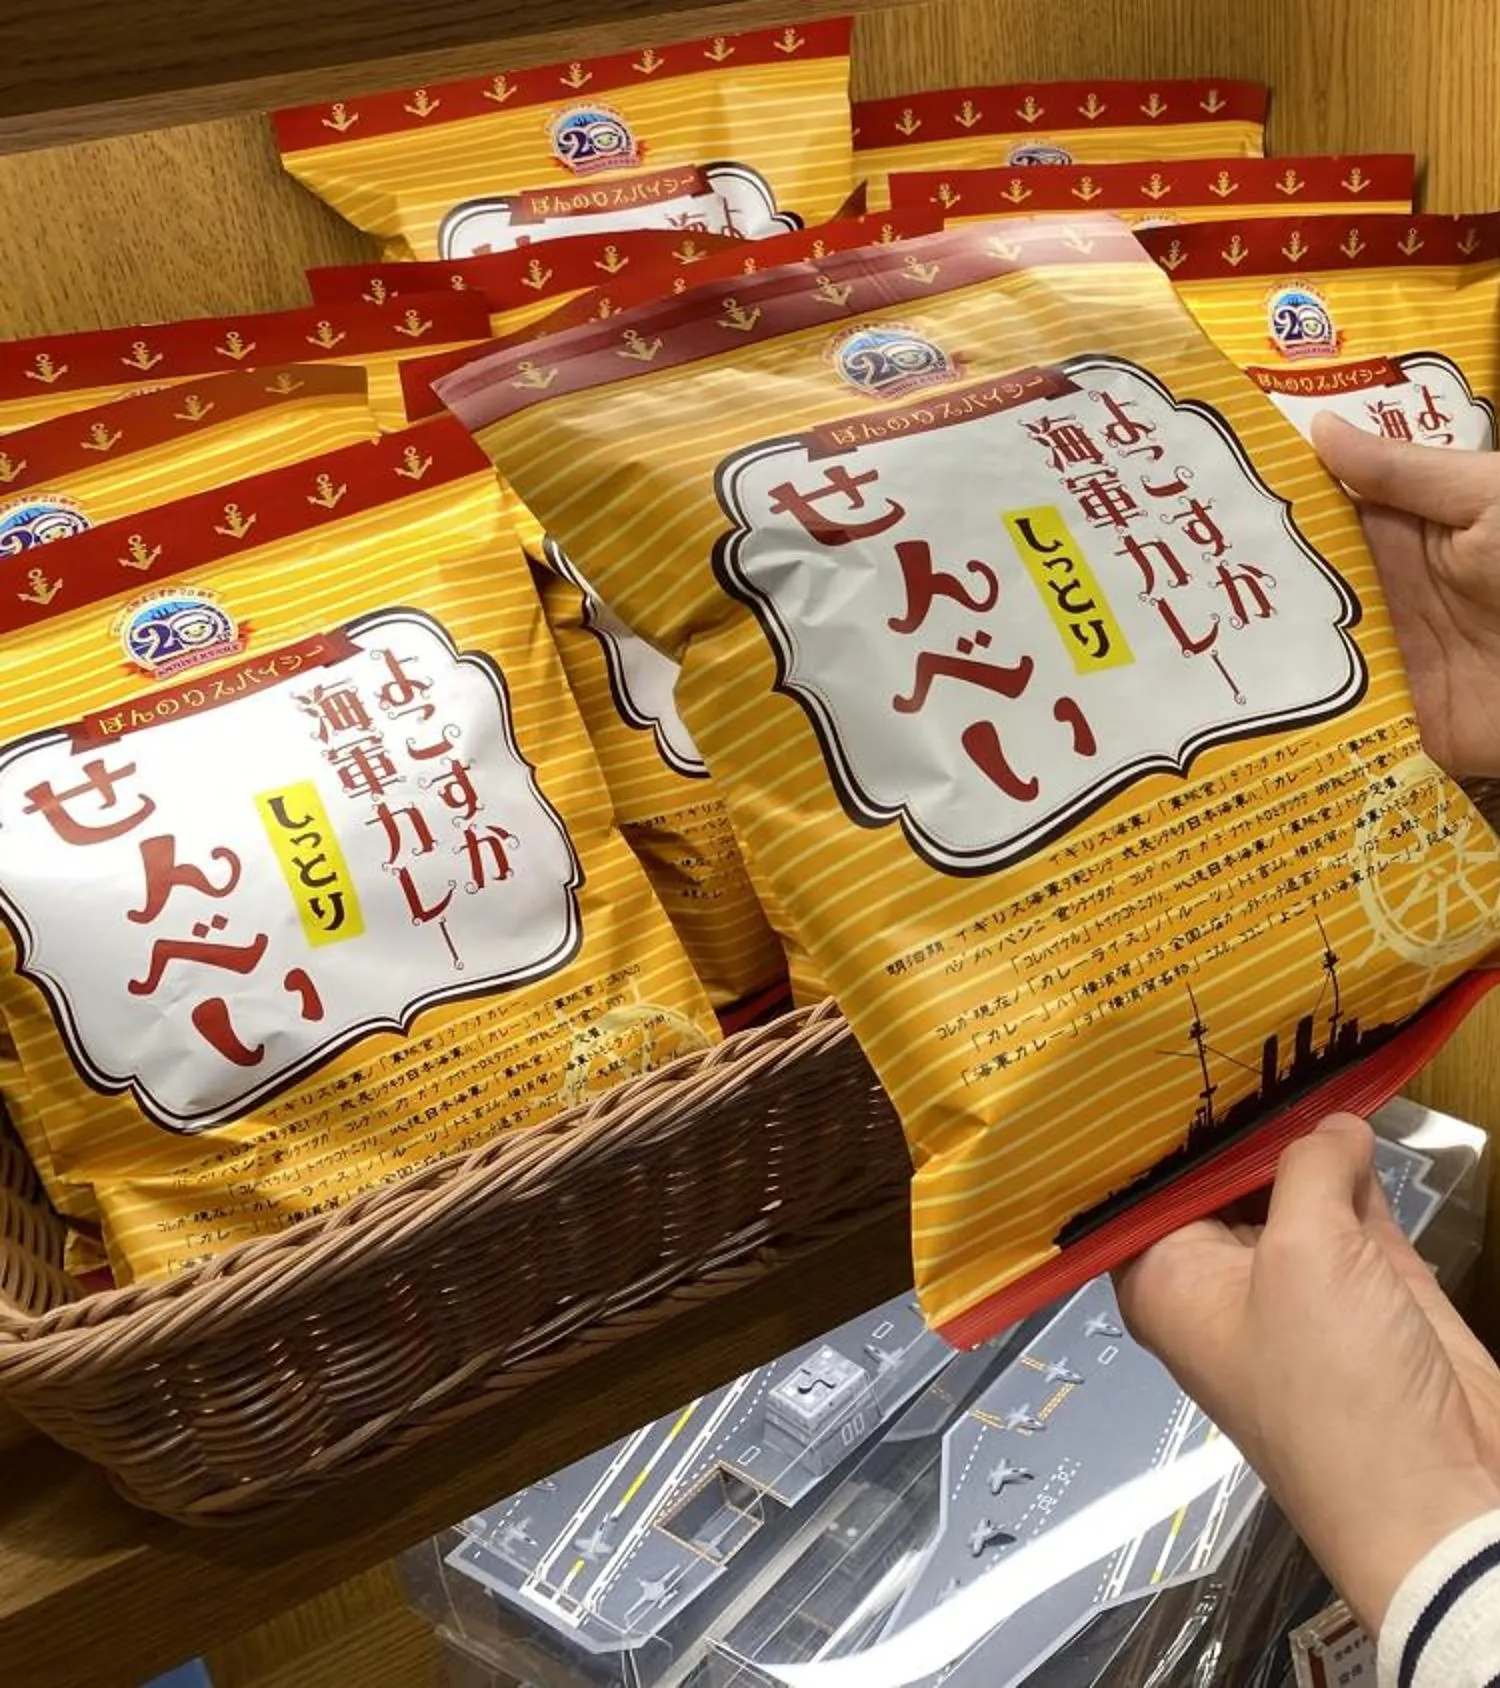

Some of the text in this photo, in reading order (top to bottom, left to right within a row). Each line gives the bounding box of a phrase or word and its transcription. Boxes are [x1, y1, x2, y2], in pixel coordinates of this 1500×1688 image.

[831, 374, 1046, 447] ほんのりスパイシー
[1097, 390, 1279, 630] よこすか
[767, 464, 1098, 802] せんべい
[1013, 516, 1110, 658] しっとり
[1025, 415, 1248, 706] 海軍カレー
[100, 644, 324, 735] ほんのりスパイシー
[378, 647, 519, 893] よこすか
[23, 758, 325, 1068] せんべい
[268, 794, 348, 931] しっとり
[296, 680, 466, 972] 海軍カレー
